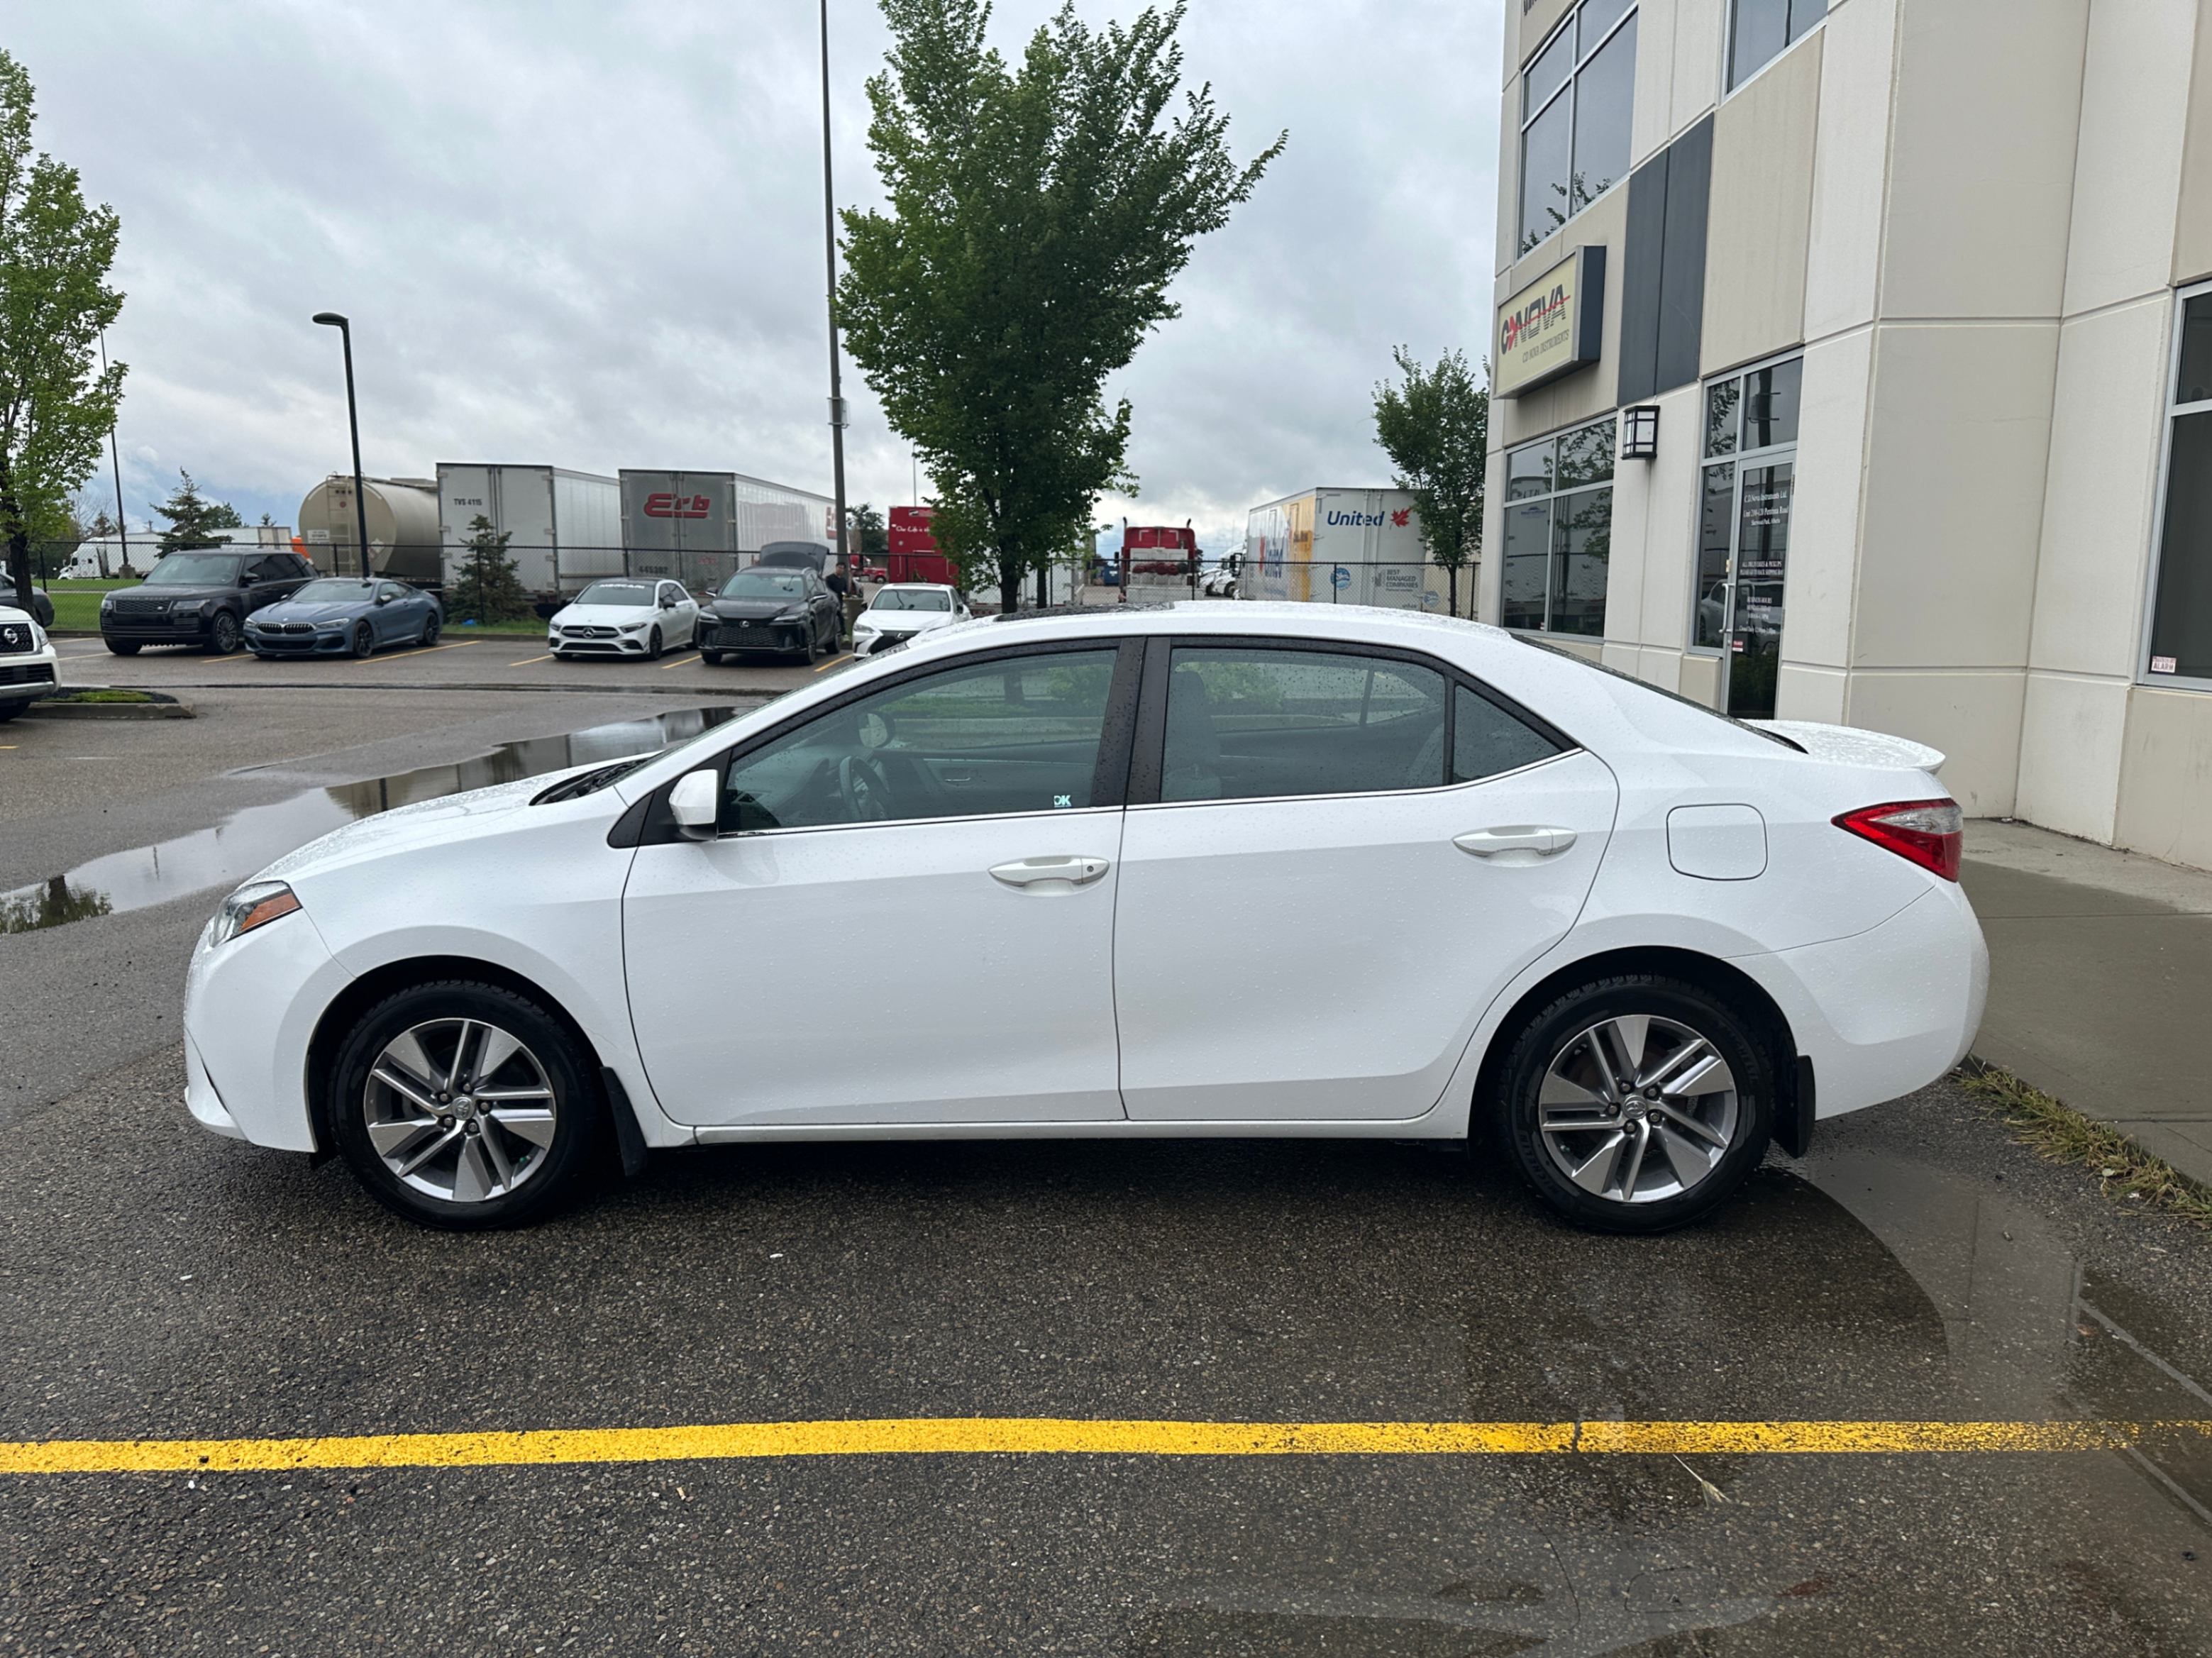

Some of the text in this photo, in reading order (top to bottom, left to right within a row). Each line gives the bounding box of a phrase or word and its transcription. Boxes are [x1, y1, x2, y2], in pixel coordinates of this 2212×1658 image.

[643, 493, 711, 519] Erb
[1327, 510, 1386, 526] United
[2153, 661, 2174, 671] ALARM
